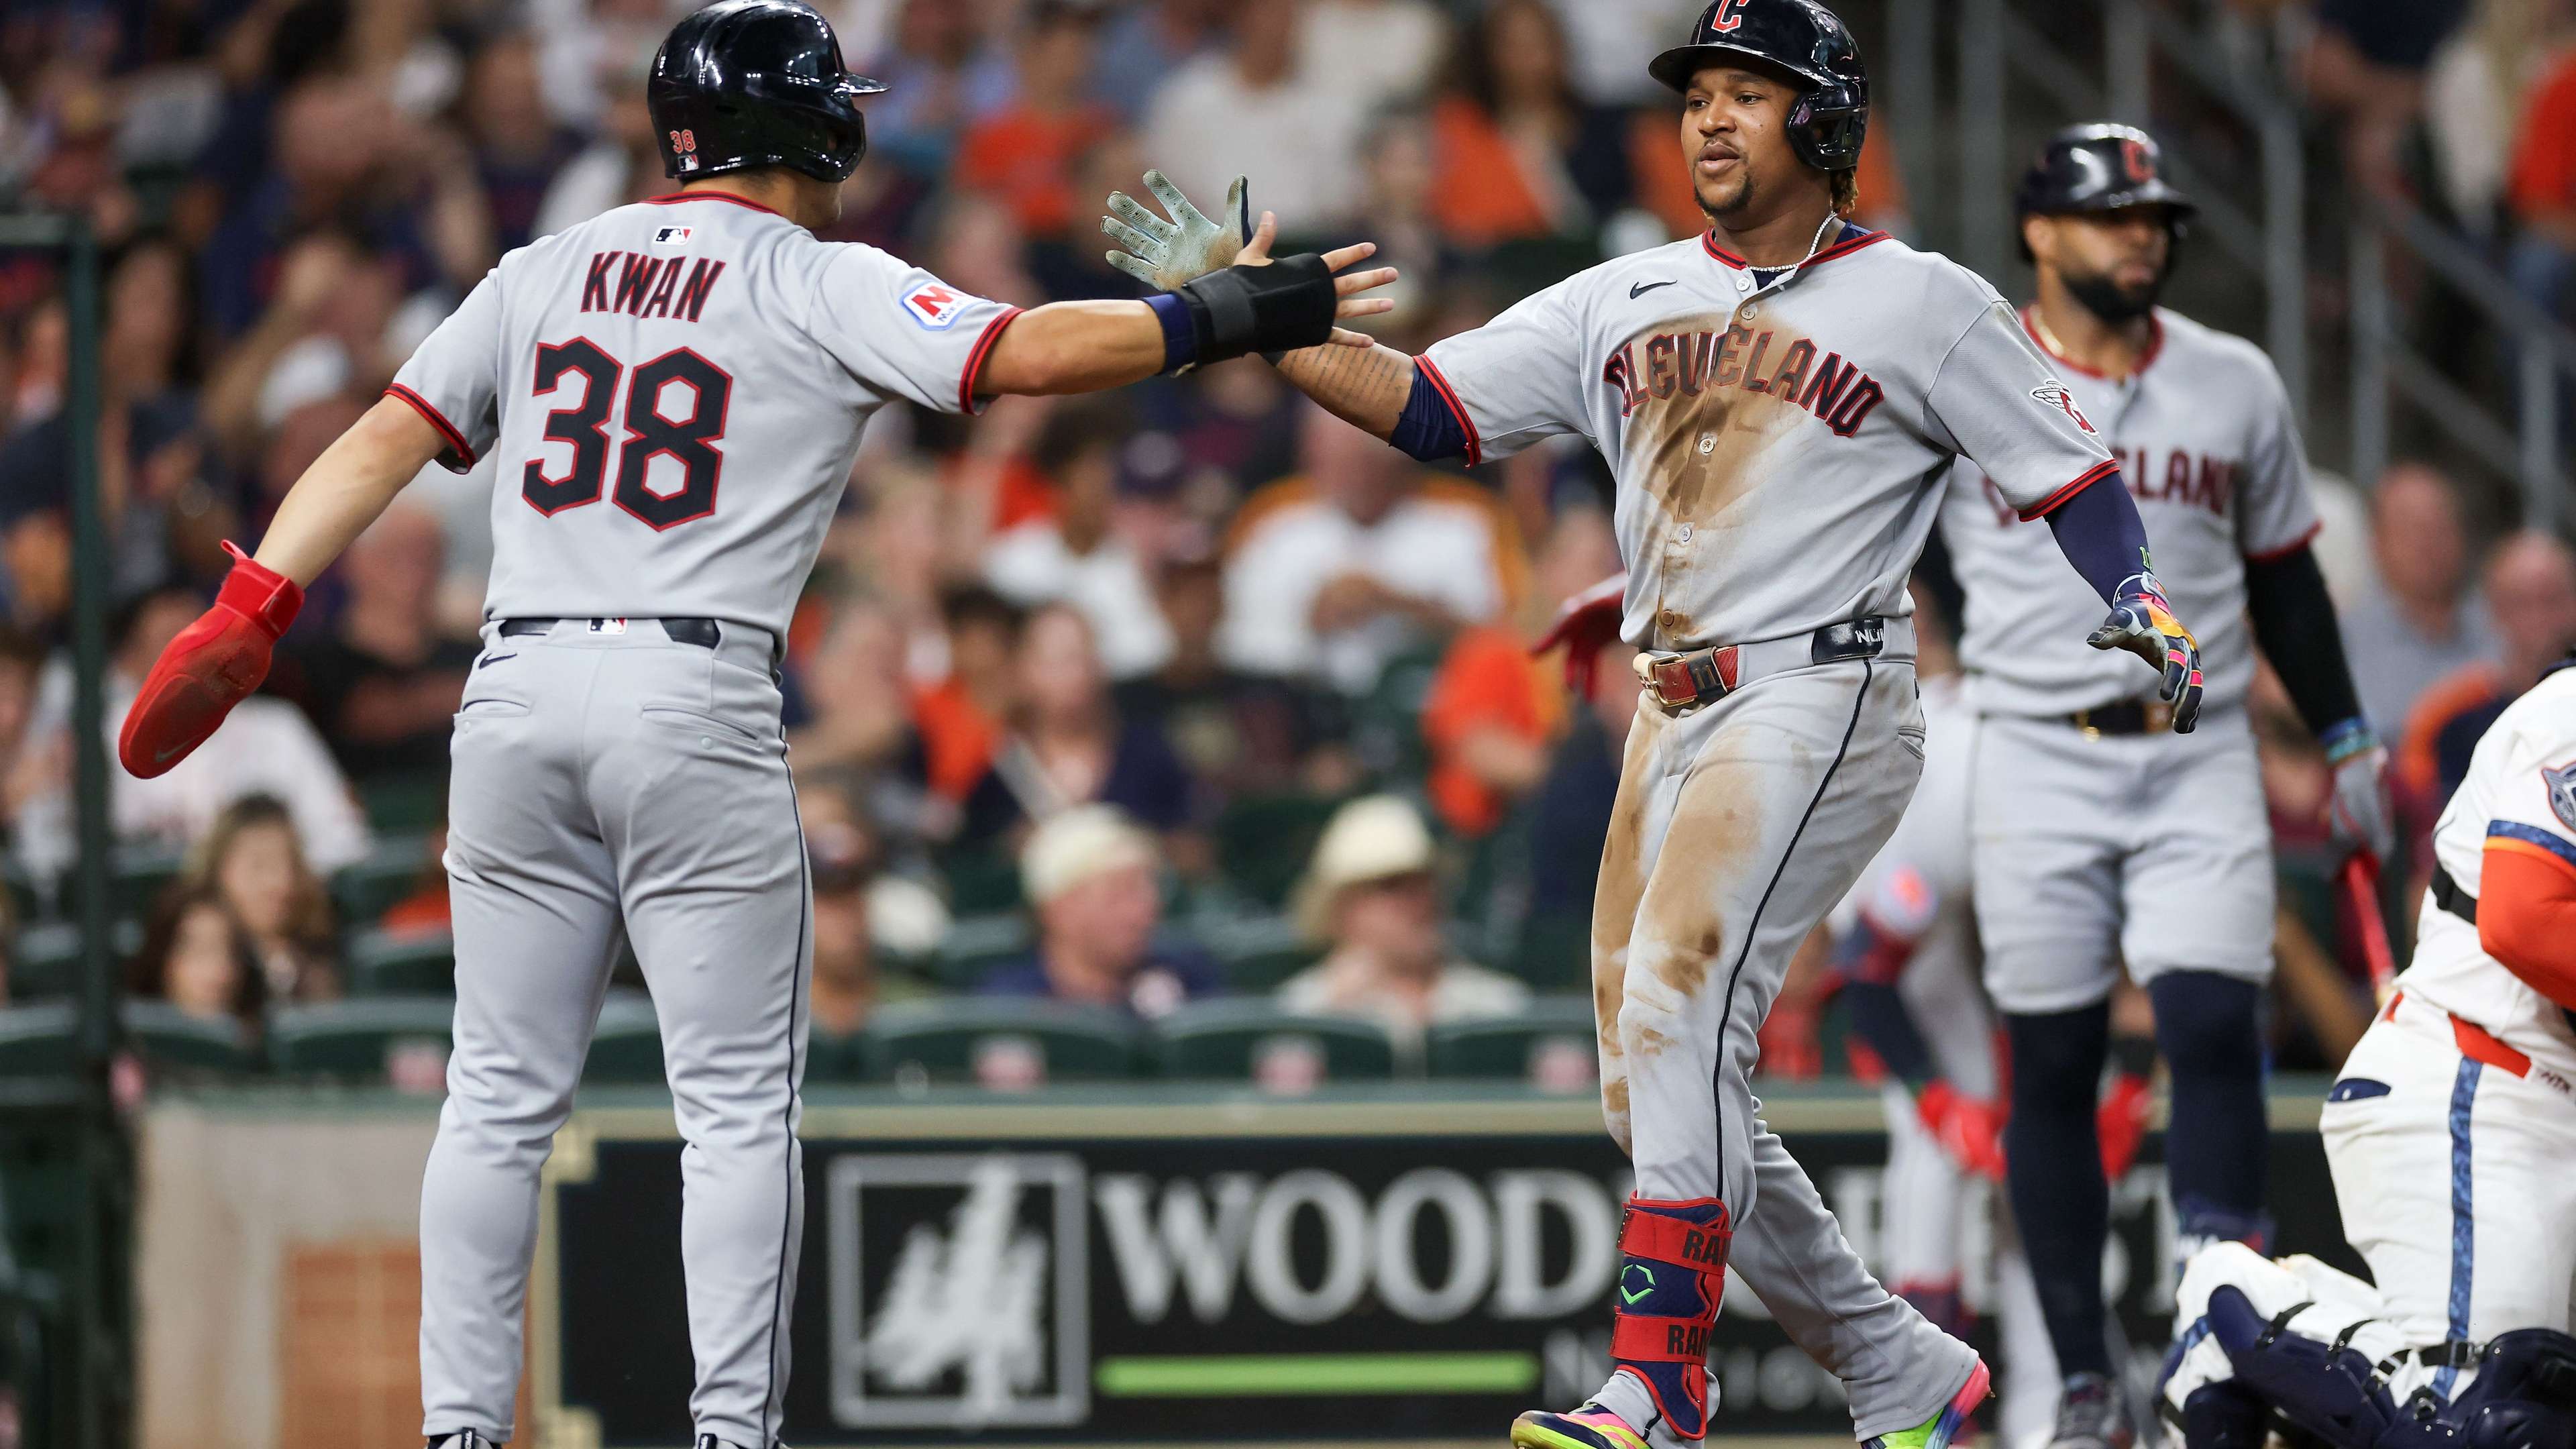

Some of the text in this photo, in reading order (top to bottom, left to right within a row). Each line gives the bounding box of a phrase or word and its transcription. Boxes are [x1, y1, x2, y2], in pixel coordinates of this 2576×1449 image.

[669, 129, 696, 154] 38
[580, 251, 727, 323] KWAN
[1603, 321, 1884, 438] CLEVELAND
[521, 335, 733, 533] 38
